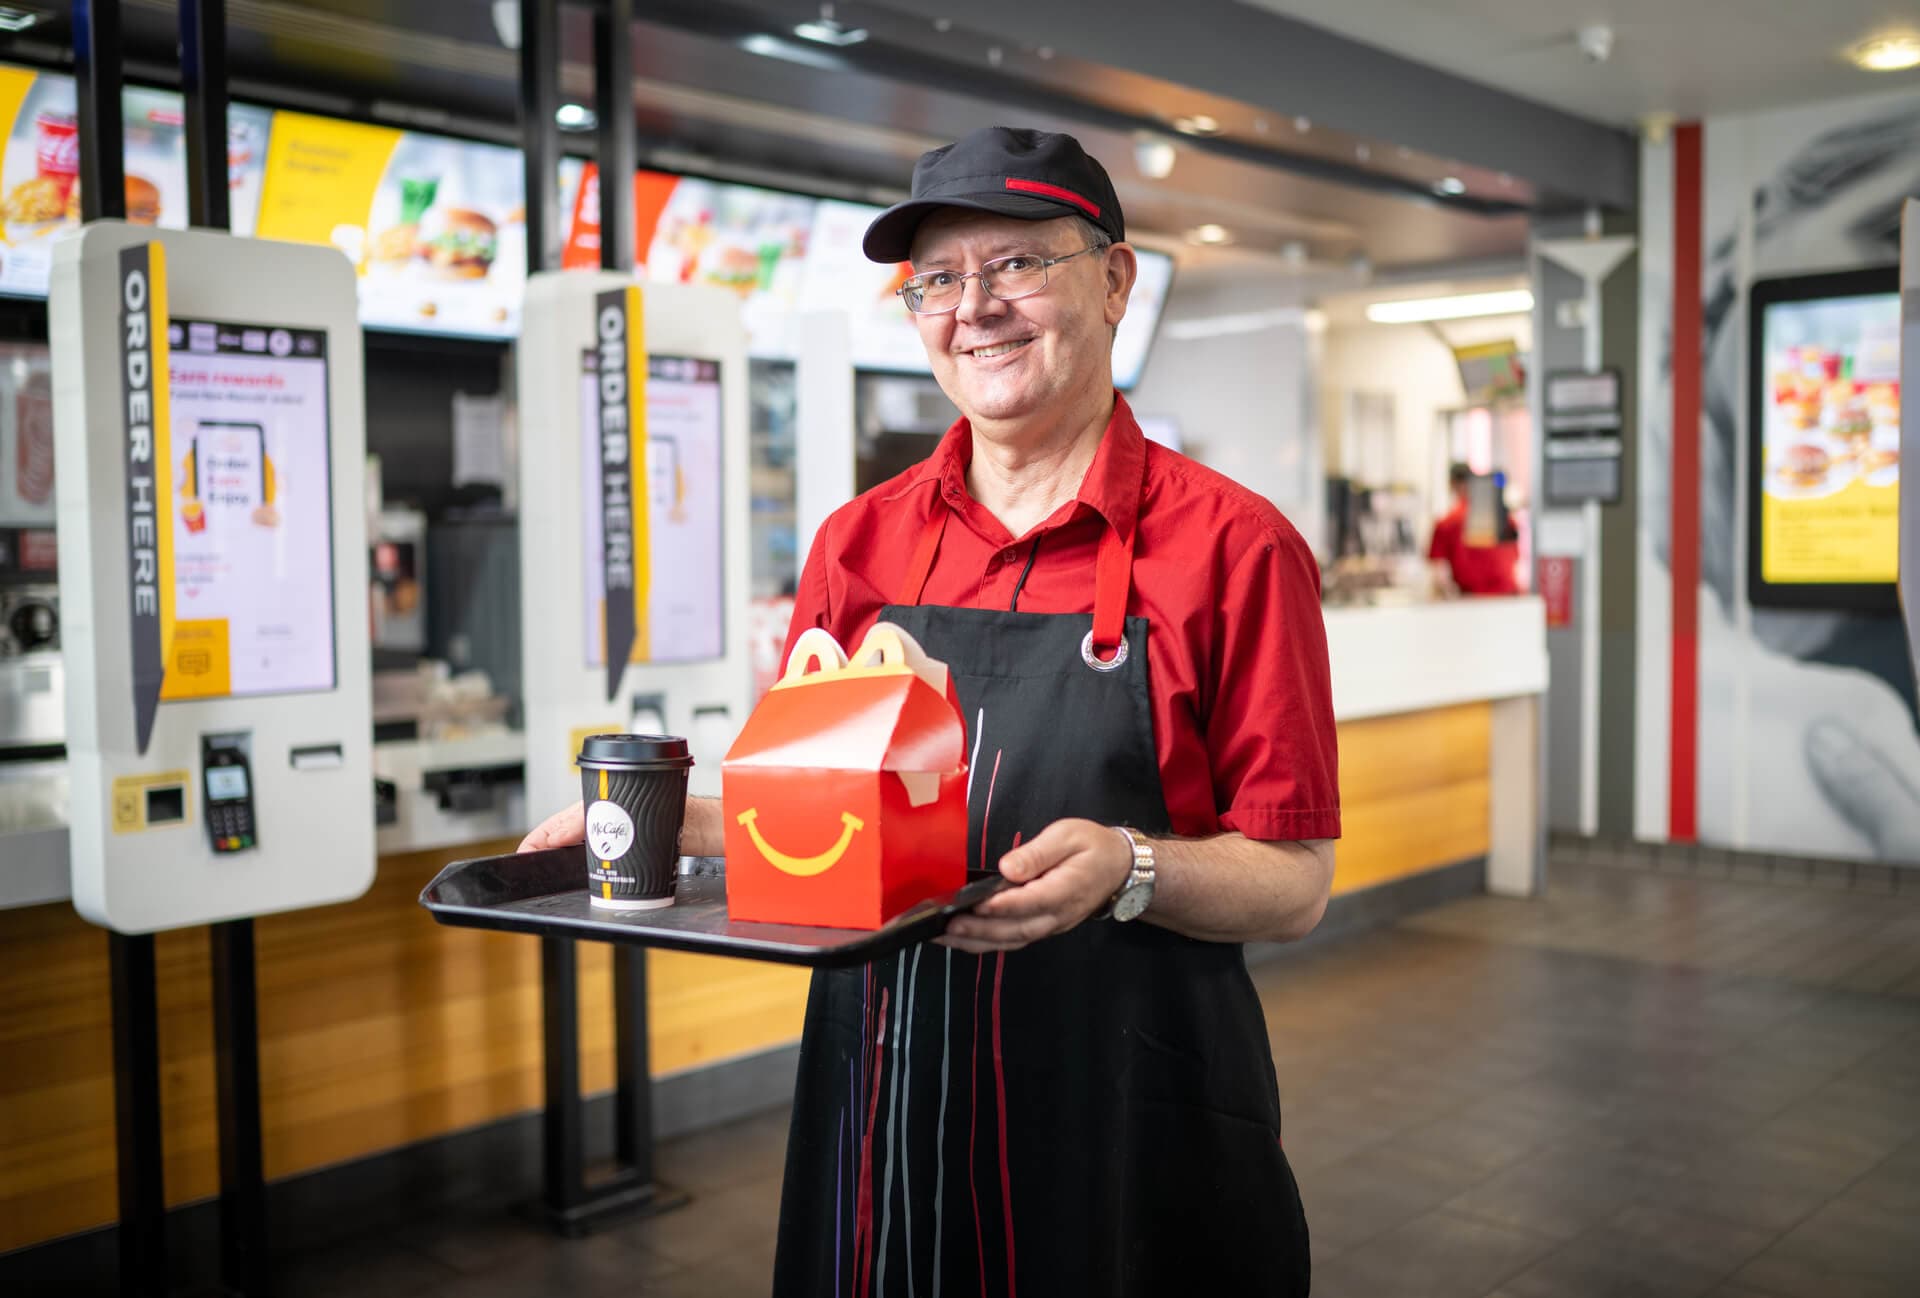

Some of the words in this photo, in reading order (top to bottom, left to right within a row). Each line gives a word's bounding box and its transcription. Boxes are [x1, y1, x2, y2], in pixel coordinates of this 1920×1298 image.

[125, 270, 151, 463] ORDER
[600, 304, 628, 464] ORDER
[132, 476, 156, 616] HERE
[605, 472, 633, 590] HERE
